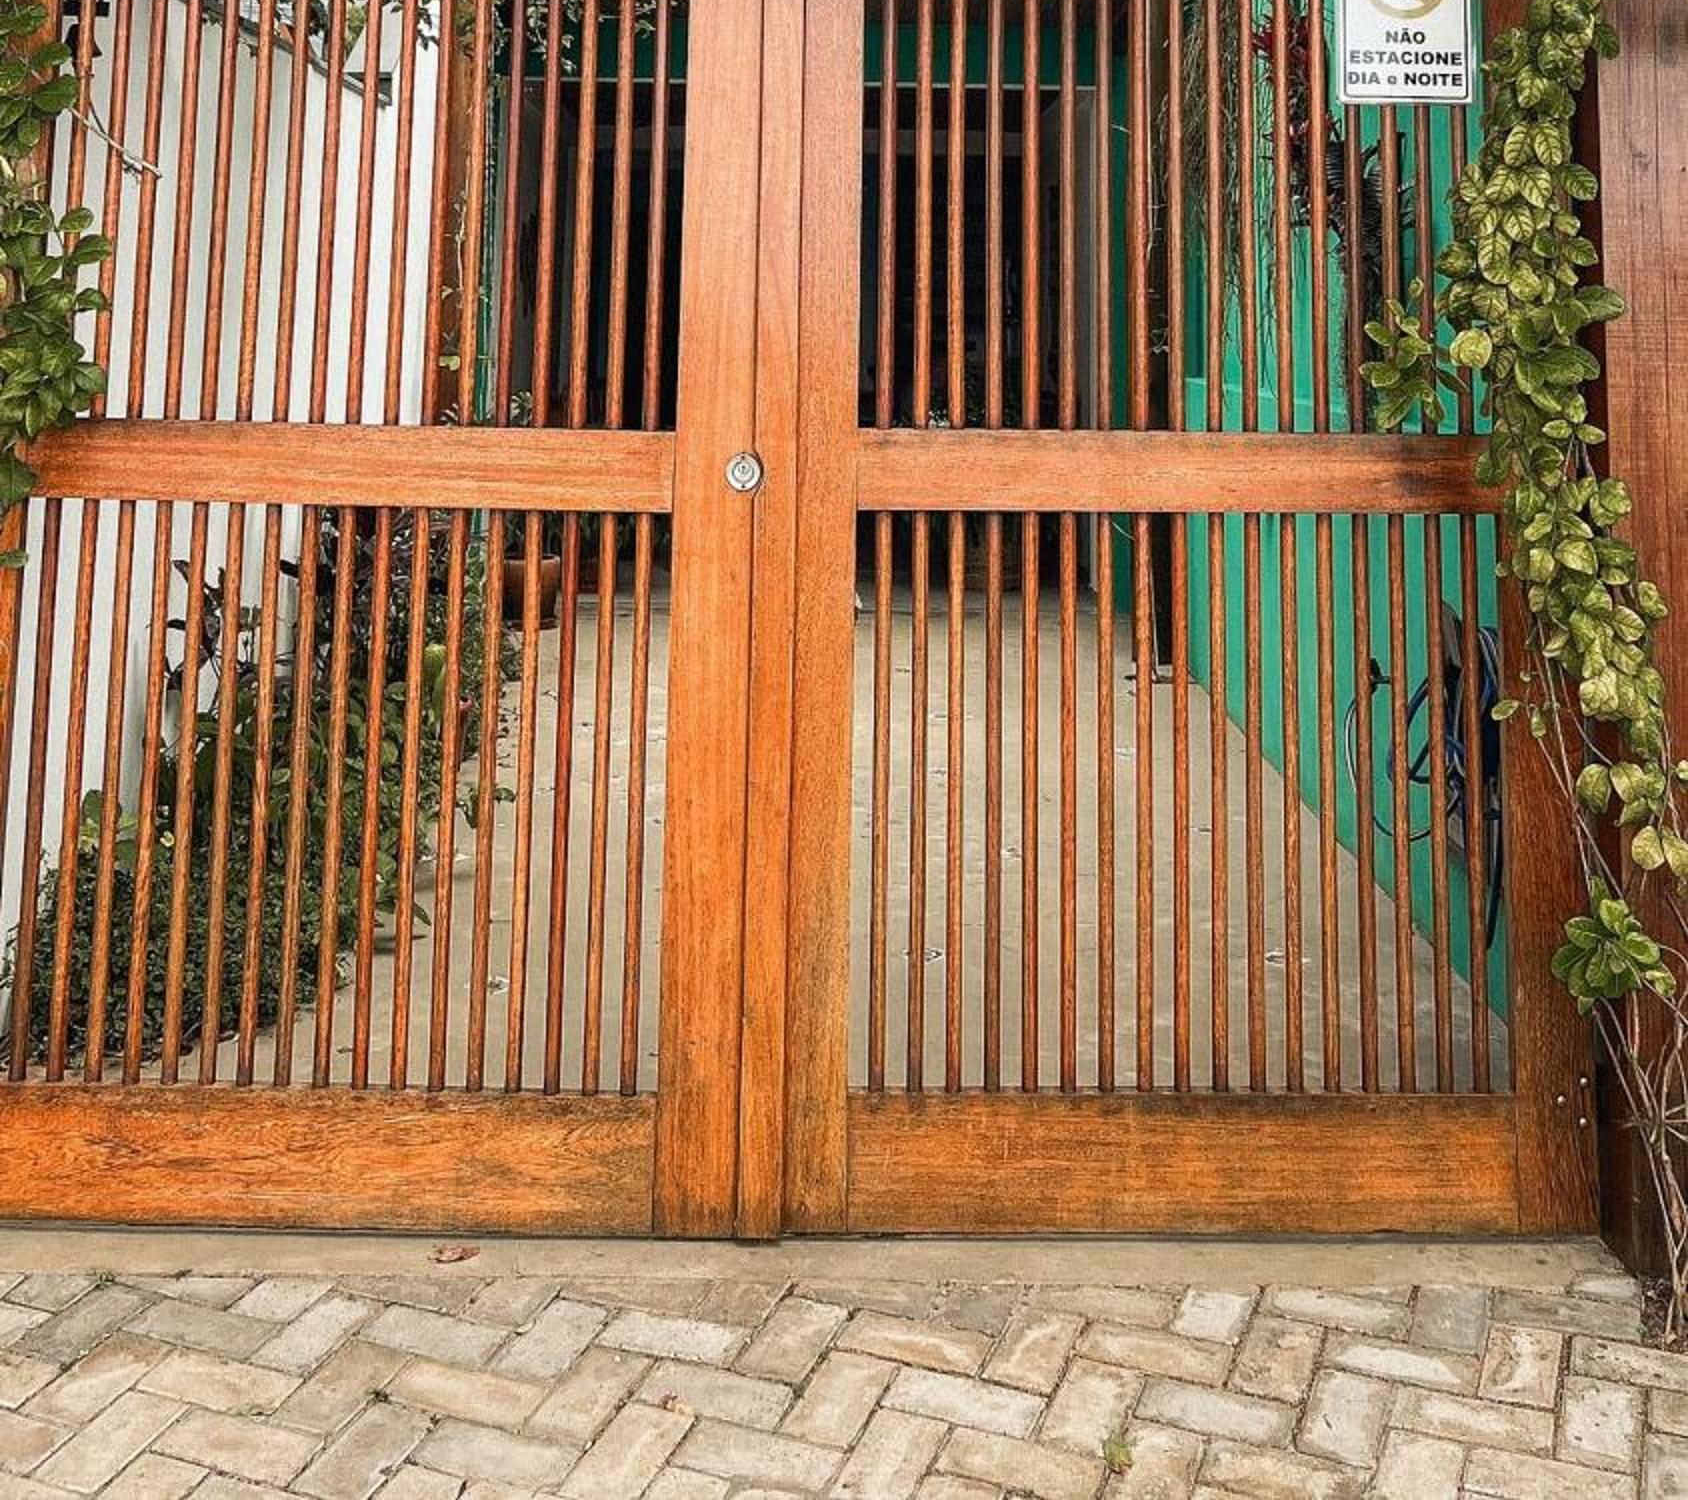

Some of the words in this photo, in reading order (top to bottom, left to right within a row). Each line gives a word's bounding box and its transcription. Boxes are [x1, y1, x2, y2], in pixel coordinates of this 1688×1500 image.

[1385, 27, 1425, 45] NÃO
[1349, 50, 1463, 66] ESTACIONE
[1348, 72, 1381, 85] DIA
[1387, 74, 1397, 85] e
[1403, 72, 1463, 86] NOITE
